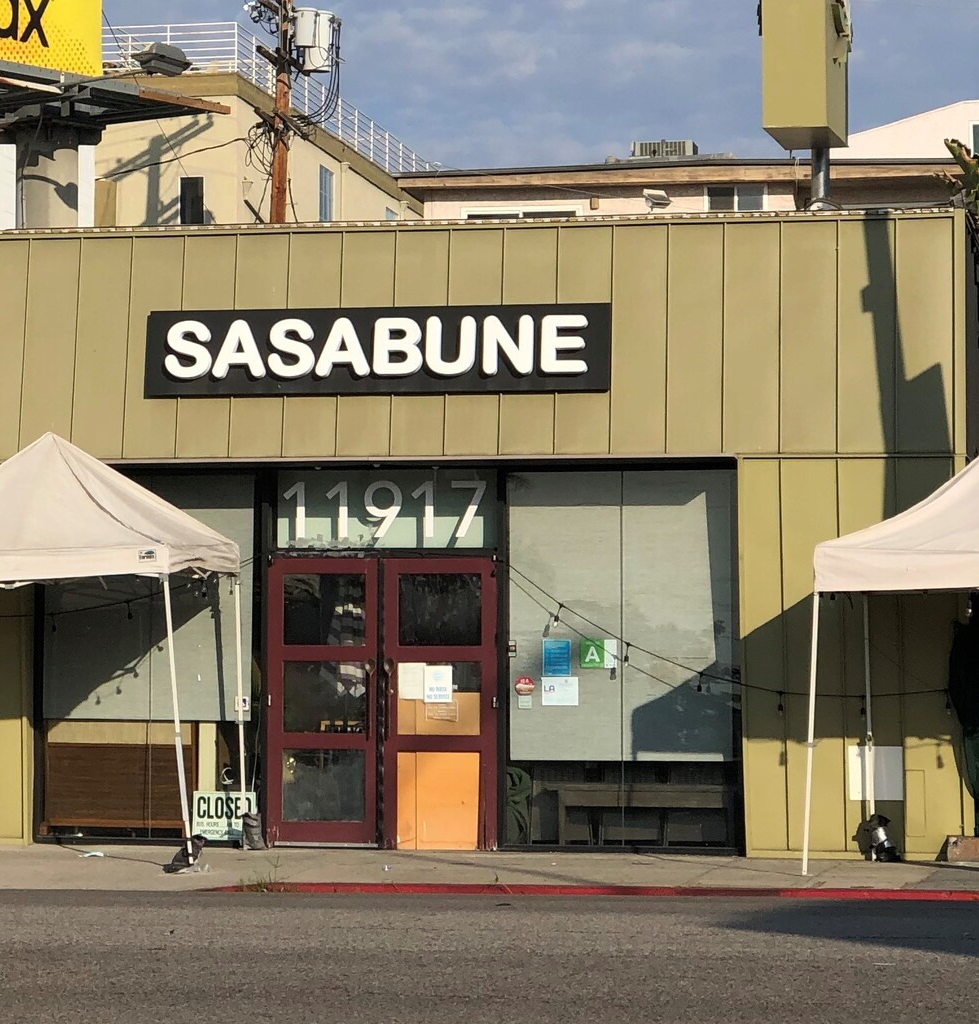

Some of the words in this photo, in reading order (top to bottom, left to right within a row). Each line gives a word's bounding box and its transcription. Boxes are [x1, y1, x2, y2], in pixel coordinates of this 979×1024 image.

[164, 314, 590, 379] SASABUNE
[282, 479, 487, 538] 11917
[584, 646, 601, 663] A
